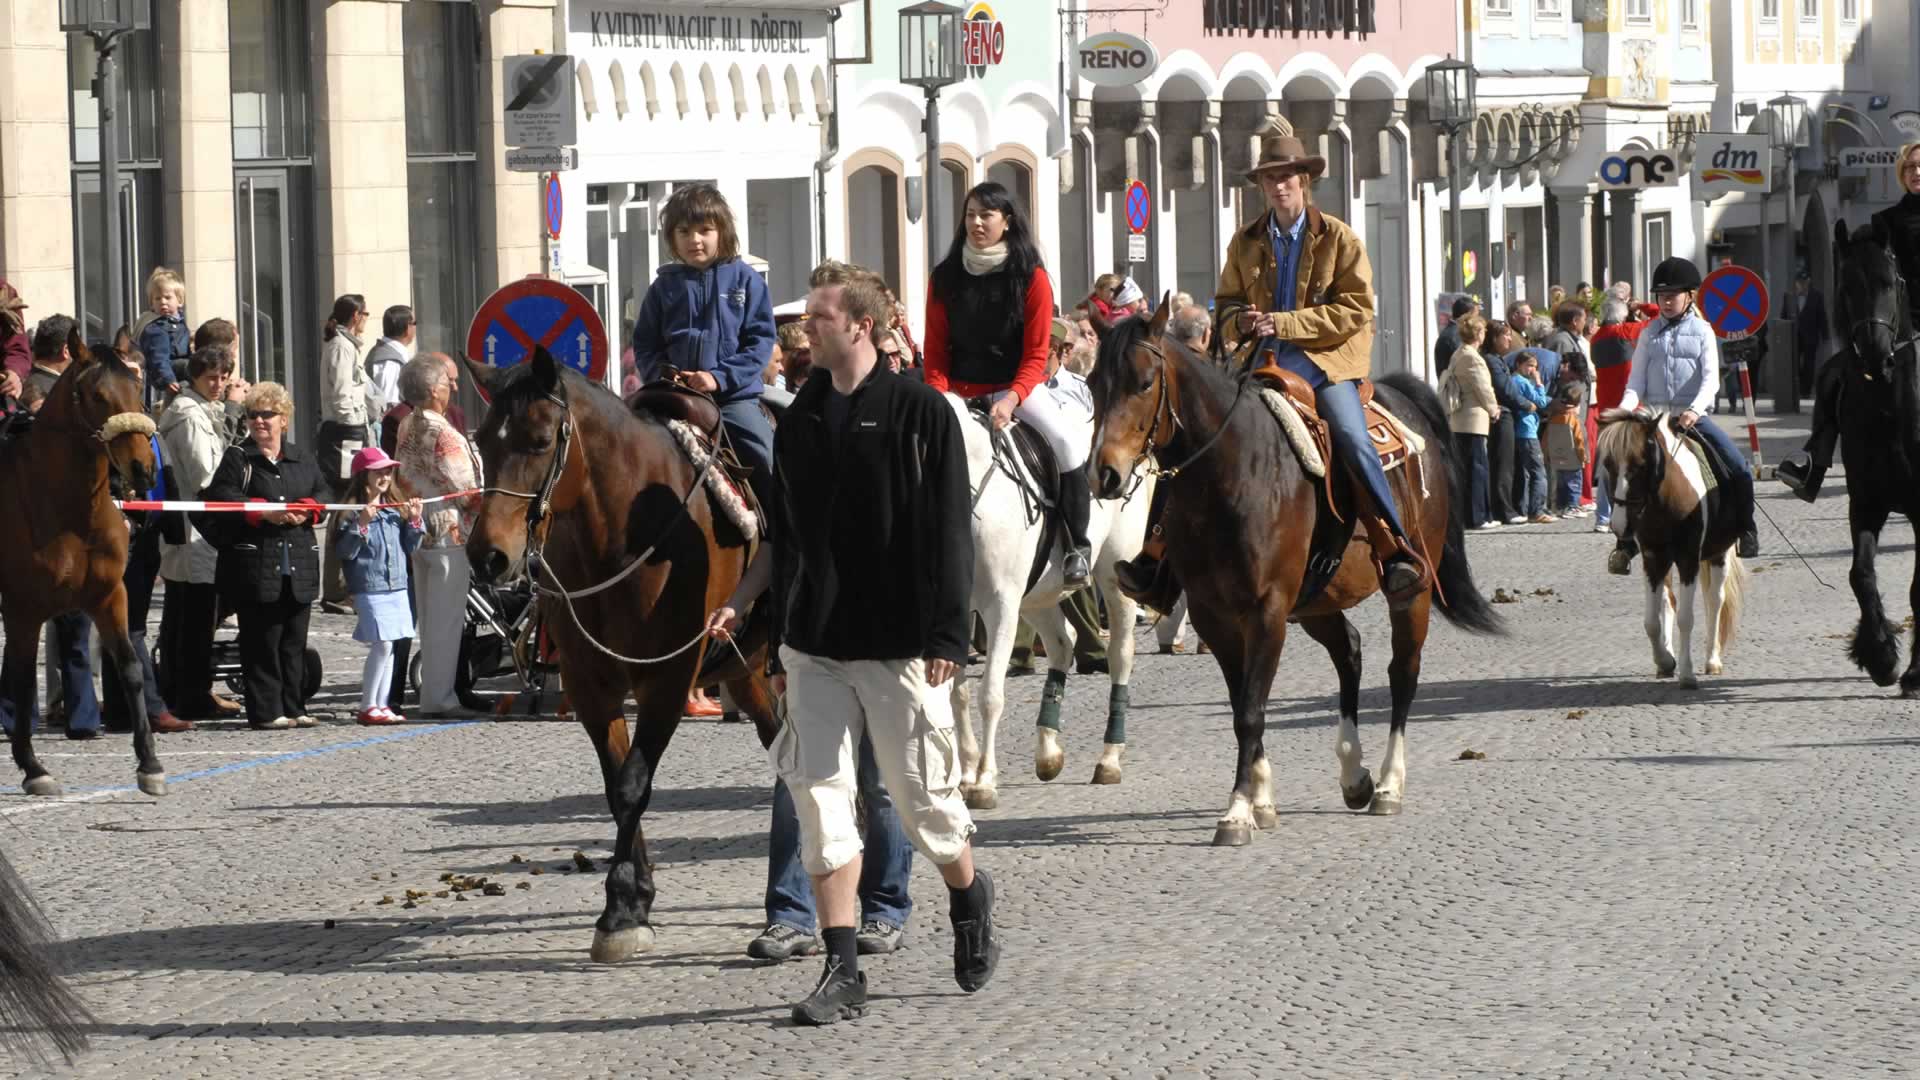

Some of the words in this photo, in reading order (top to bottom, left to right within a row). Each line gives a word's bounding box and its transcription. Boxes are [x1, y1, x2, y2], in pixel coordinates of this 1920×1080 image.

[1080, 50, 1147, 69] RENO
[1712, 141, 1758, 168] dm
[1600, 154, 1674, 185] one
